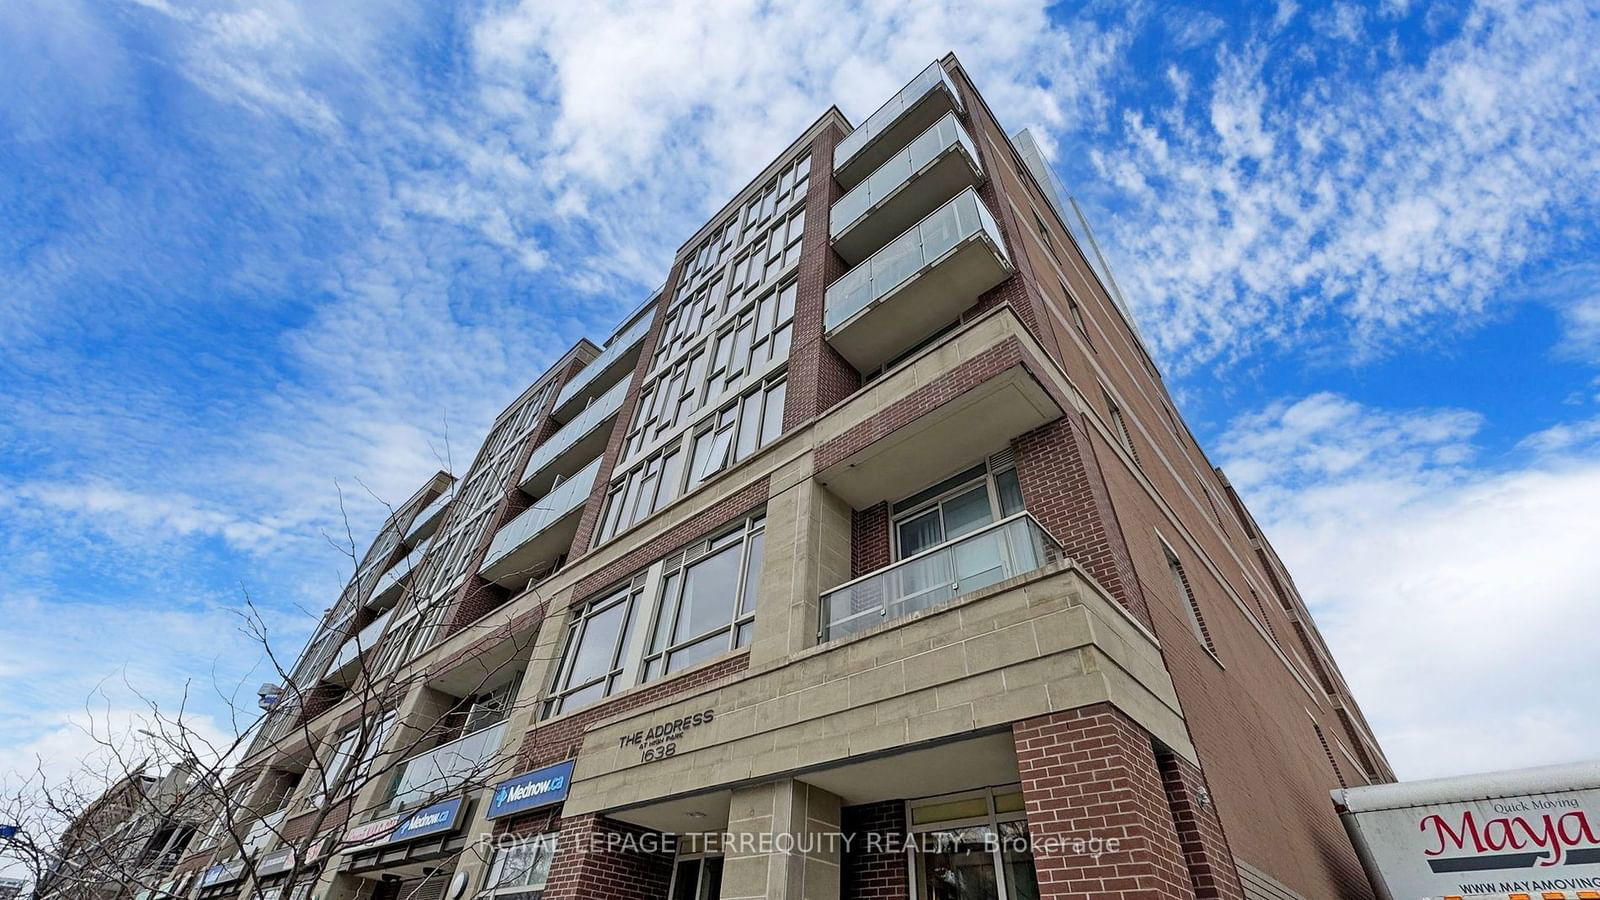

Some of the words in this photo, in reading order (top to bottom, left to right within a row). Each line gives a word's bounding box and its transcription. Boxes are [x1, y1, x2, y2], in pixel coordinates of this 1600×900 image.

[619, 730, 644, 748] THE
[645, 709, 714, 741] ADDRESS
[639, 742, 648, 751] AT
[648, 736, 665, 747] HIGH
[665, 731, 684, 743] PARK
[640, 742, 677, 763] 1638
[507, 774, 564, 802] Mednow.ca
[1494, 800, 1529, 814] Quick
[1532, 798, 1579, 811] Moving
[408, 809, 450, 831] Mednow.ca
[1420, 810, 1600, 867] Maya
